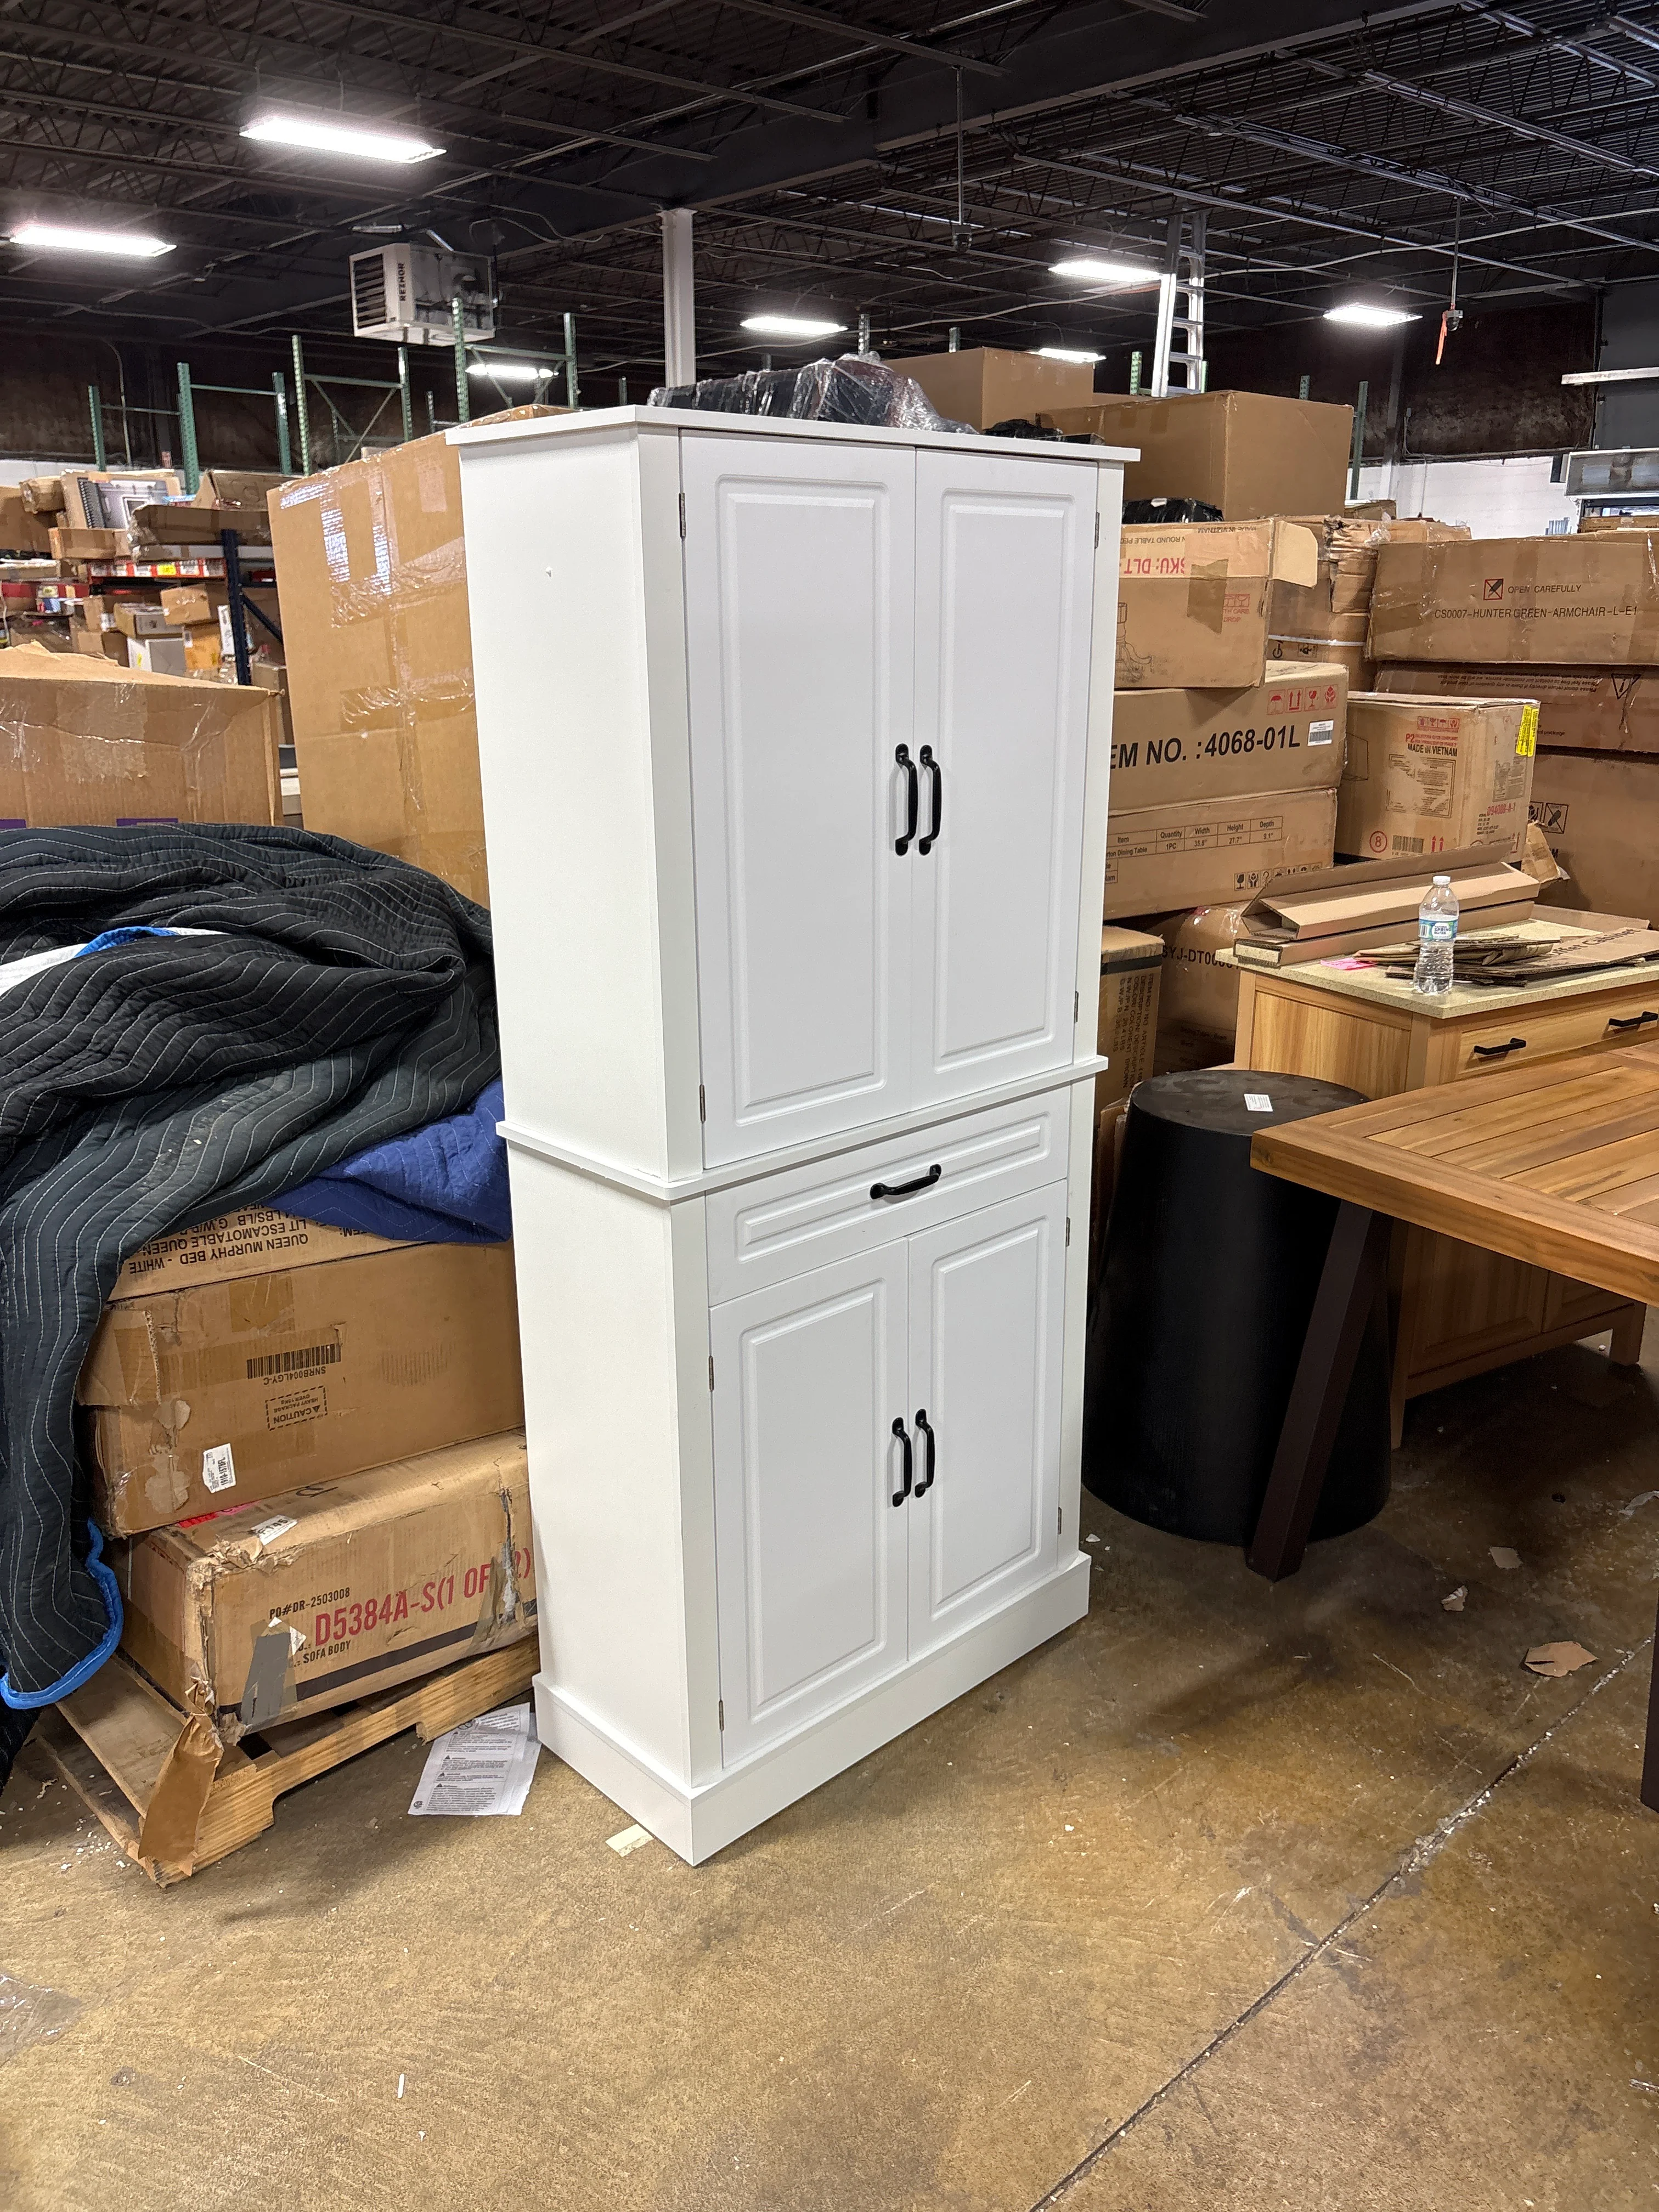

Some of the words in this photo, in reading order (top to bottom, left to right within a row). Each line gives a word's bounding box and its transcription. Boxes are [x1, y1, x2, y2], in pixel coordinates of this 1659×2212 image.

[398, 263, 407, 302] REZNOR
[1123, 558, 1152, 574] DLT
[1508, 585, 1531, 594] OPEN
[1533, 584, 1582, 594] CAREFULLY
[1435, 608, 1511, 619] CS0007-HUNTER
[1146, 737, 1187, 765] NO.
[1407, 743, 1424, 753] MADE
[1432, 746, 1458, 757] VIETNAM
[1160, 831, 1182, 839] Quantity
[1194, 827, 1210, 835] Width
[1227, 823, 1244, 832] Height
[1259, 820, 1274, 829] Depth
[1117, 848, 1133, 857] Dining
[1166, 842, 1177, 850] 1PC
[1552, 944, 1588, 956] ffet
[1582, 929, 1642, 945] Cabinet
[1161, 945, 1239, 970] SYJ-DT00
[286, 1218, 307, 1232] LIT
[190, 1221, 286, 1248] ESCAMOTABLE
[266, 1233, 308, 1251] QUEEN
[179, 1250, 206, 1265] BED
[210, 1238, 263, 1260] MURPHY
[128, 1256, 165, 1274] WHITE
[263, 1365, 326, 1385] SNRB004LGY-C
[273, 1402, 300, 1413] PACKAGE
[300, 1397, 319, 1407] HEAVY
[273, 1407, 312, 1424] CAUTION
[269, 1587, 351, 1618] PO#DR-2503008
[315, 1576, 454, 1646] D5384A-S(1
[464, 1564, 492, 1598] OF
[303, 1650, 326, 1664] SOFA
[328, 1640, 351, 1656] BODY
